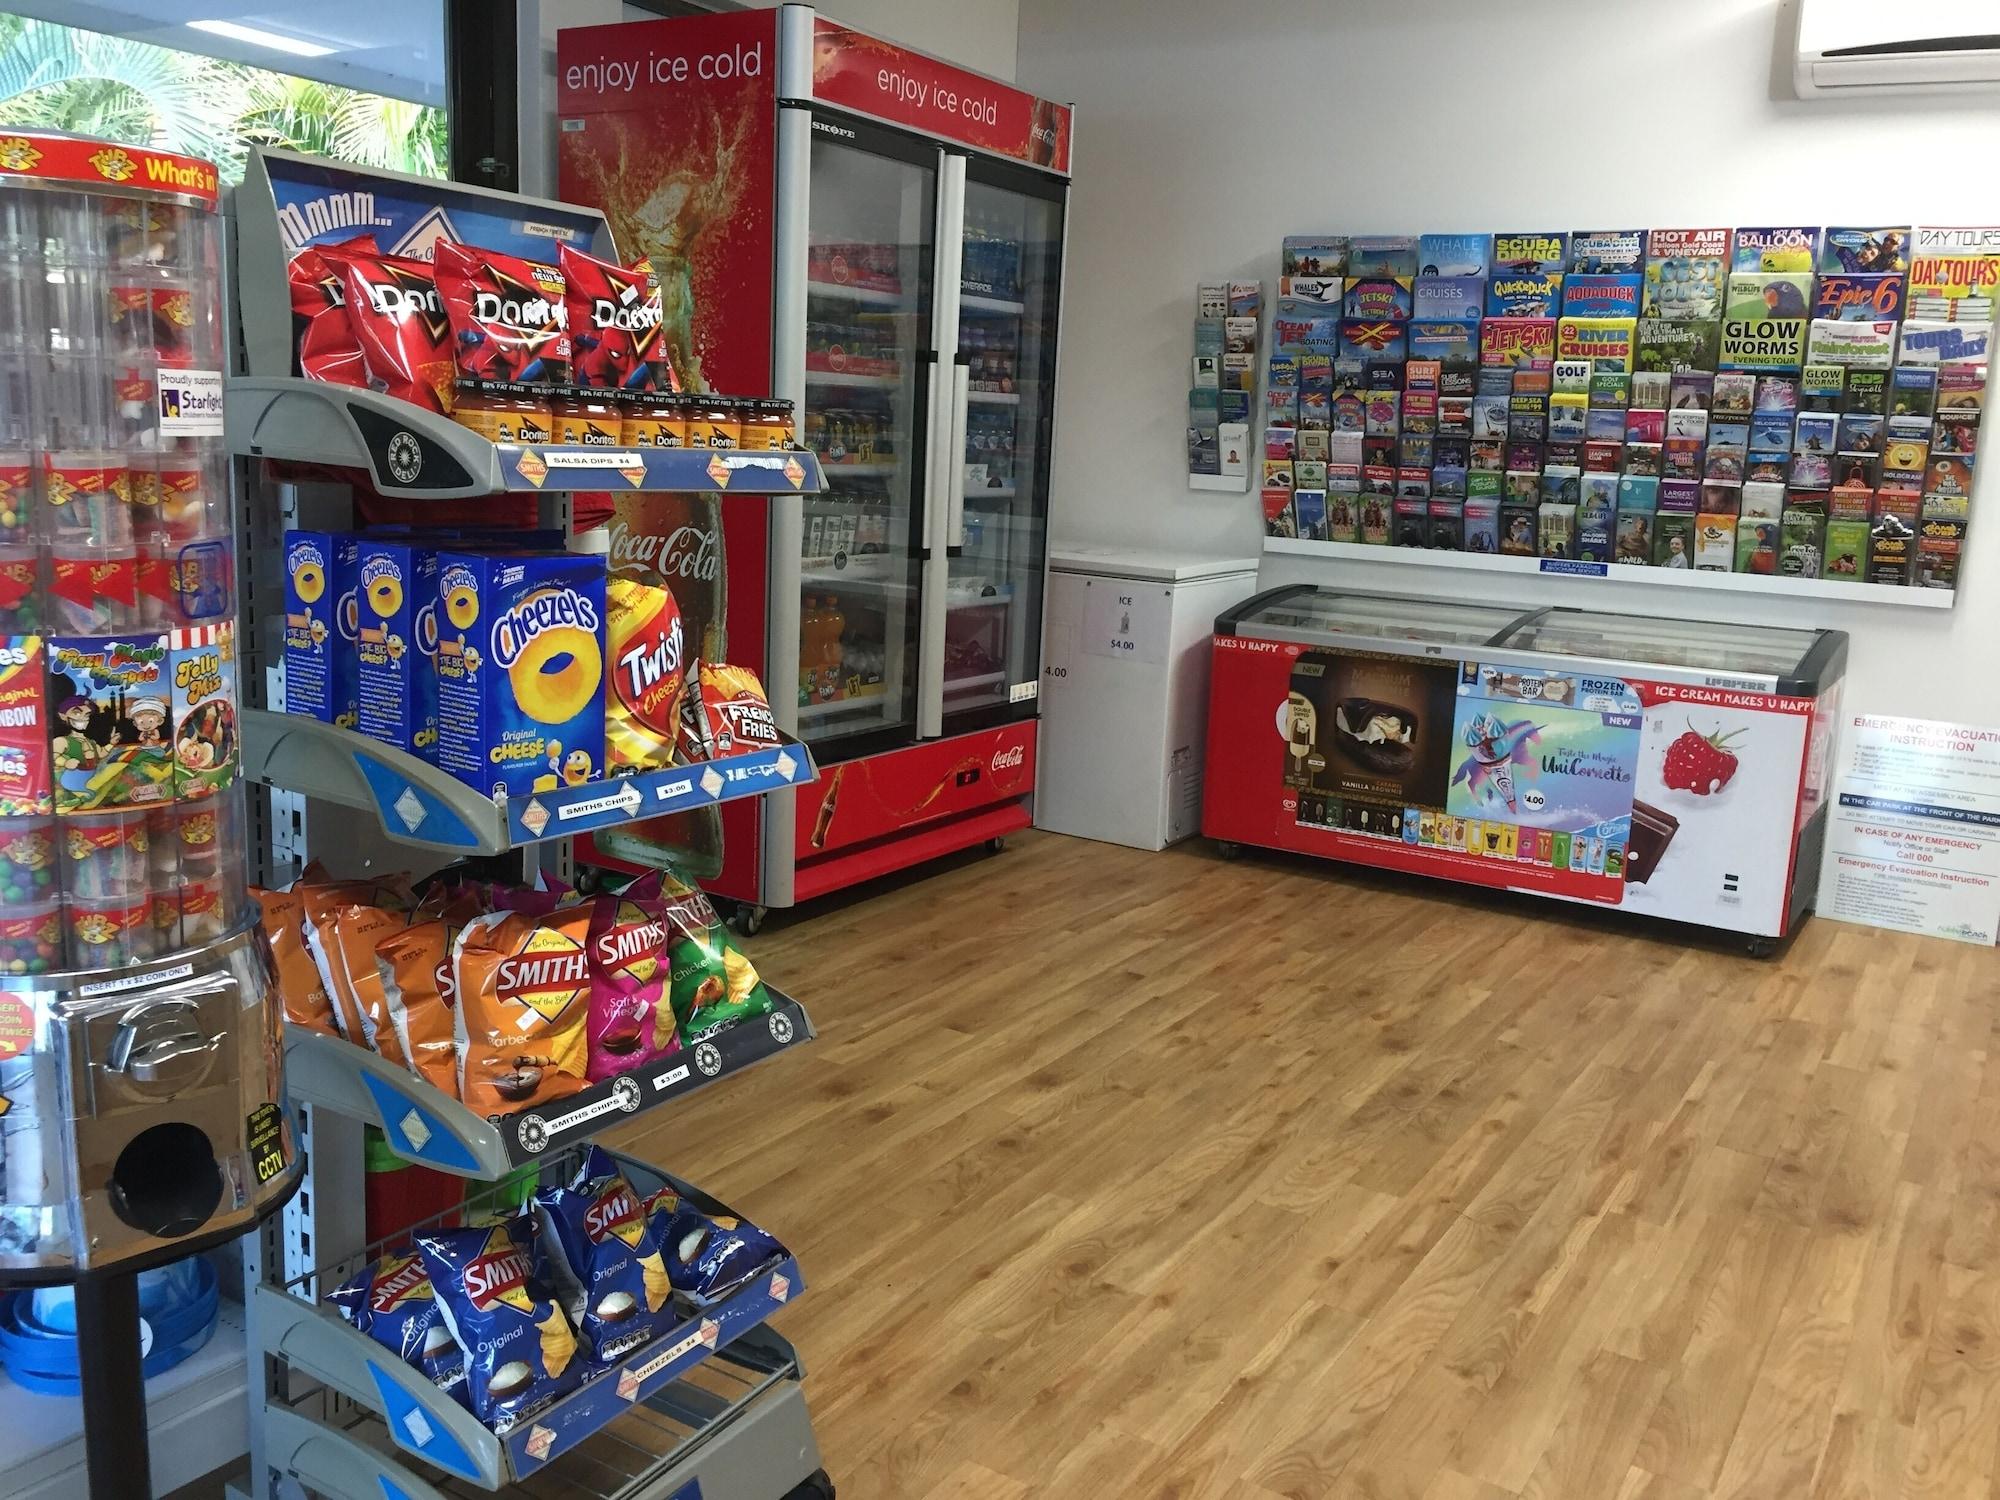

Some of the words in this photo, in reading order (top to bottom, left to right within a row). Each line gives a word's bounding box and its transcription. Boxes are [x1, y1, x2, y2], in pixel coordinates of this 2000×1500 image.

[566, 58, 638, 93] enjoy
[649, 50, 689, 84] ice
[697, 41, 762, 81] cold
[876, 67, 928, 108] enjoy
[932, 80, 958, 113] ice
[961, 92, 998, 127] cold
[145, 157, 204, 188] What's
[206, 169, 215, 191] in
[1653, 231, 1690, 242] HOT
[1695, 231, 1727, 242] AIR
[1772, 229, 1789, 237] HOT
[1920, 230, 1952, 246] DAY
[1428, 238, 1480, 251] WHALE
[1497, 239, 1562, 251] SCUBA
[1738, 233, 1814, 248] BALLOON
[1497, 250, 1561, 262] DIVING
[1651, 248, 1661, 256] &
[1664, 247, 1726, 257] VINEYARD
[1911, 259, 1943, 285] DAY
[1944, 259, 1999, 287] TOURS
[1294, 283, 1319, 292] WHALES
[1418, 288, 1463, 299] CRUISES
[1566, 286, 1636, 302] AQUADUCK
[1818, 280, 1873, 311] Epic
[1872, 277, 1901, 314] 6
[1578, 329, 1629, 343] RIVER
[1726, 321, 1800, 339] GLOW
[1640, 333, 1695, 344] ADVENTURE?
[1559, 343, 1630, 357] CRUISES
[1724, 340, 1800, 356] WORMS
[1733, 356, 1769, 365] EVENING
[1770, 356, 1796, 365] TOUR
[1372, 370, 1395, 378] SEA
[1409, 366, 1435, 375] SURF
[1556, 366, 1587, 377] GOLF
[1806, 370, 1841, 379] GLOW
[161, 373, 193, 387] Proudly
[1805, 378, 1840, 387] WORMS
[519, 429, 550, 442] Doritos
[584, 433, 616, 446] Doritos
[656, 435, 683, 447] Doritos
[553, 457, 588, 465] SALSA
[394, 467, 416, 480] DELI
[361, 560, 403, 590] Cheezels
[440, 571, 479, 601] Cheezels
[1118, 595, 1133, 607] ICE
[490, 588, 600, 669] Cheezels
[1110, 638, 1135, 651] $4.00
[1239, 639, 1247, 650] U
[1248, 641, 1280, 654] HAPPY
[1044, 665, 1068, 678] 4.00
[1302, 665, 1322, 675] NEW
[1518, 677, 1545, 688] PROTEIN
[1581, 679, 1626, 692] FROZEN
[643, 674, 680, 716] Cheese
[1522, 686, 1539, 697] BAR
[1580, 687, 1610, 696] PROTEIN
[1610, 689, 1625, 697] BAR
[1655, 685, 1677, 698] ICE
[1680, 687, 1721, 702] CREAM
[1724, 693, 1764, 708] MAKES
[1768, 698, 1778, 709] U
[1780, 700, 1816, 713] HAPPY
[1608, 716, 1633, 727] NEW
[502, 727, 537, 742] Original
[741, 718, 779, 741] FRIES
[489, 737, 545, 764] CHEESE
[991, 744, 1025, 772] Coca-Cola
[1541, 754, 1632, 784] UniCornetto
[1341, 780, 1369, 791] VANILLA
[566, 801, 603, 816] SMITHS
[605, 796, 634, 808] CHIPS
[1523, 794, 1545, 806] $4.00
[1851, 797, 1865, 805] THE
[1866, 798, 1881, 807] CAR
[1882, 801, 1902, 810] PARK
[1902, 803, 1913, 811] AT
[1914, 805, 1928, 814] THE
[1928, 807, 1953, 818] FRONT
[1954, 811, 1965, 819] OF
[1966, 813, 1981, 821] THE
[1854, 826, 1864, 835] IN
[1865, 827, 1890, 838] CASE
[1890, 830, 1903, 839] OF
[1904, 833, 1924, 843] ANY
[1925, 836, 1983, 852] EMERGENCY
[1903, 842, 1924, 851] Office
[1896, 850, 1915, 861] Call
[1916, 853, 1934, 863] 000
[1838, 856, 1888, 872] Emergency
[1888, 863, 1939, 880] Evacuation
[1940, 871, 1990, 888] Instruction
[599, 919, 665, 966] SMITH'S
[673, 957, 714, 982] Chicken
[84, 980, 118, 995] INSERT
[133, 974, 144, 985] $2
[145, 970, 167, 982] COIN
[167, 965, 190, 979] ONLY
[609, 996, 630, 1008] Salt
[551, 1109, 589, 1131] SMITHS
[590, 1097, 620, 1116] CHIPS
[258, 1149, 283, 1181] CCTV
[592, 1258, 628, 1283] Original
[477, 1325, 525, 1354] Original
[635, 1346, 683, 1379] CHEEZELS
